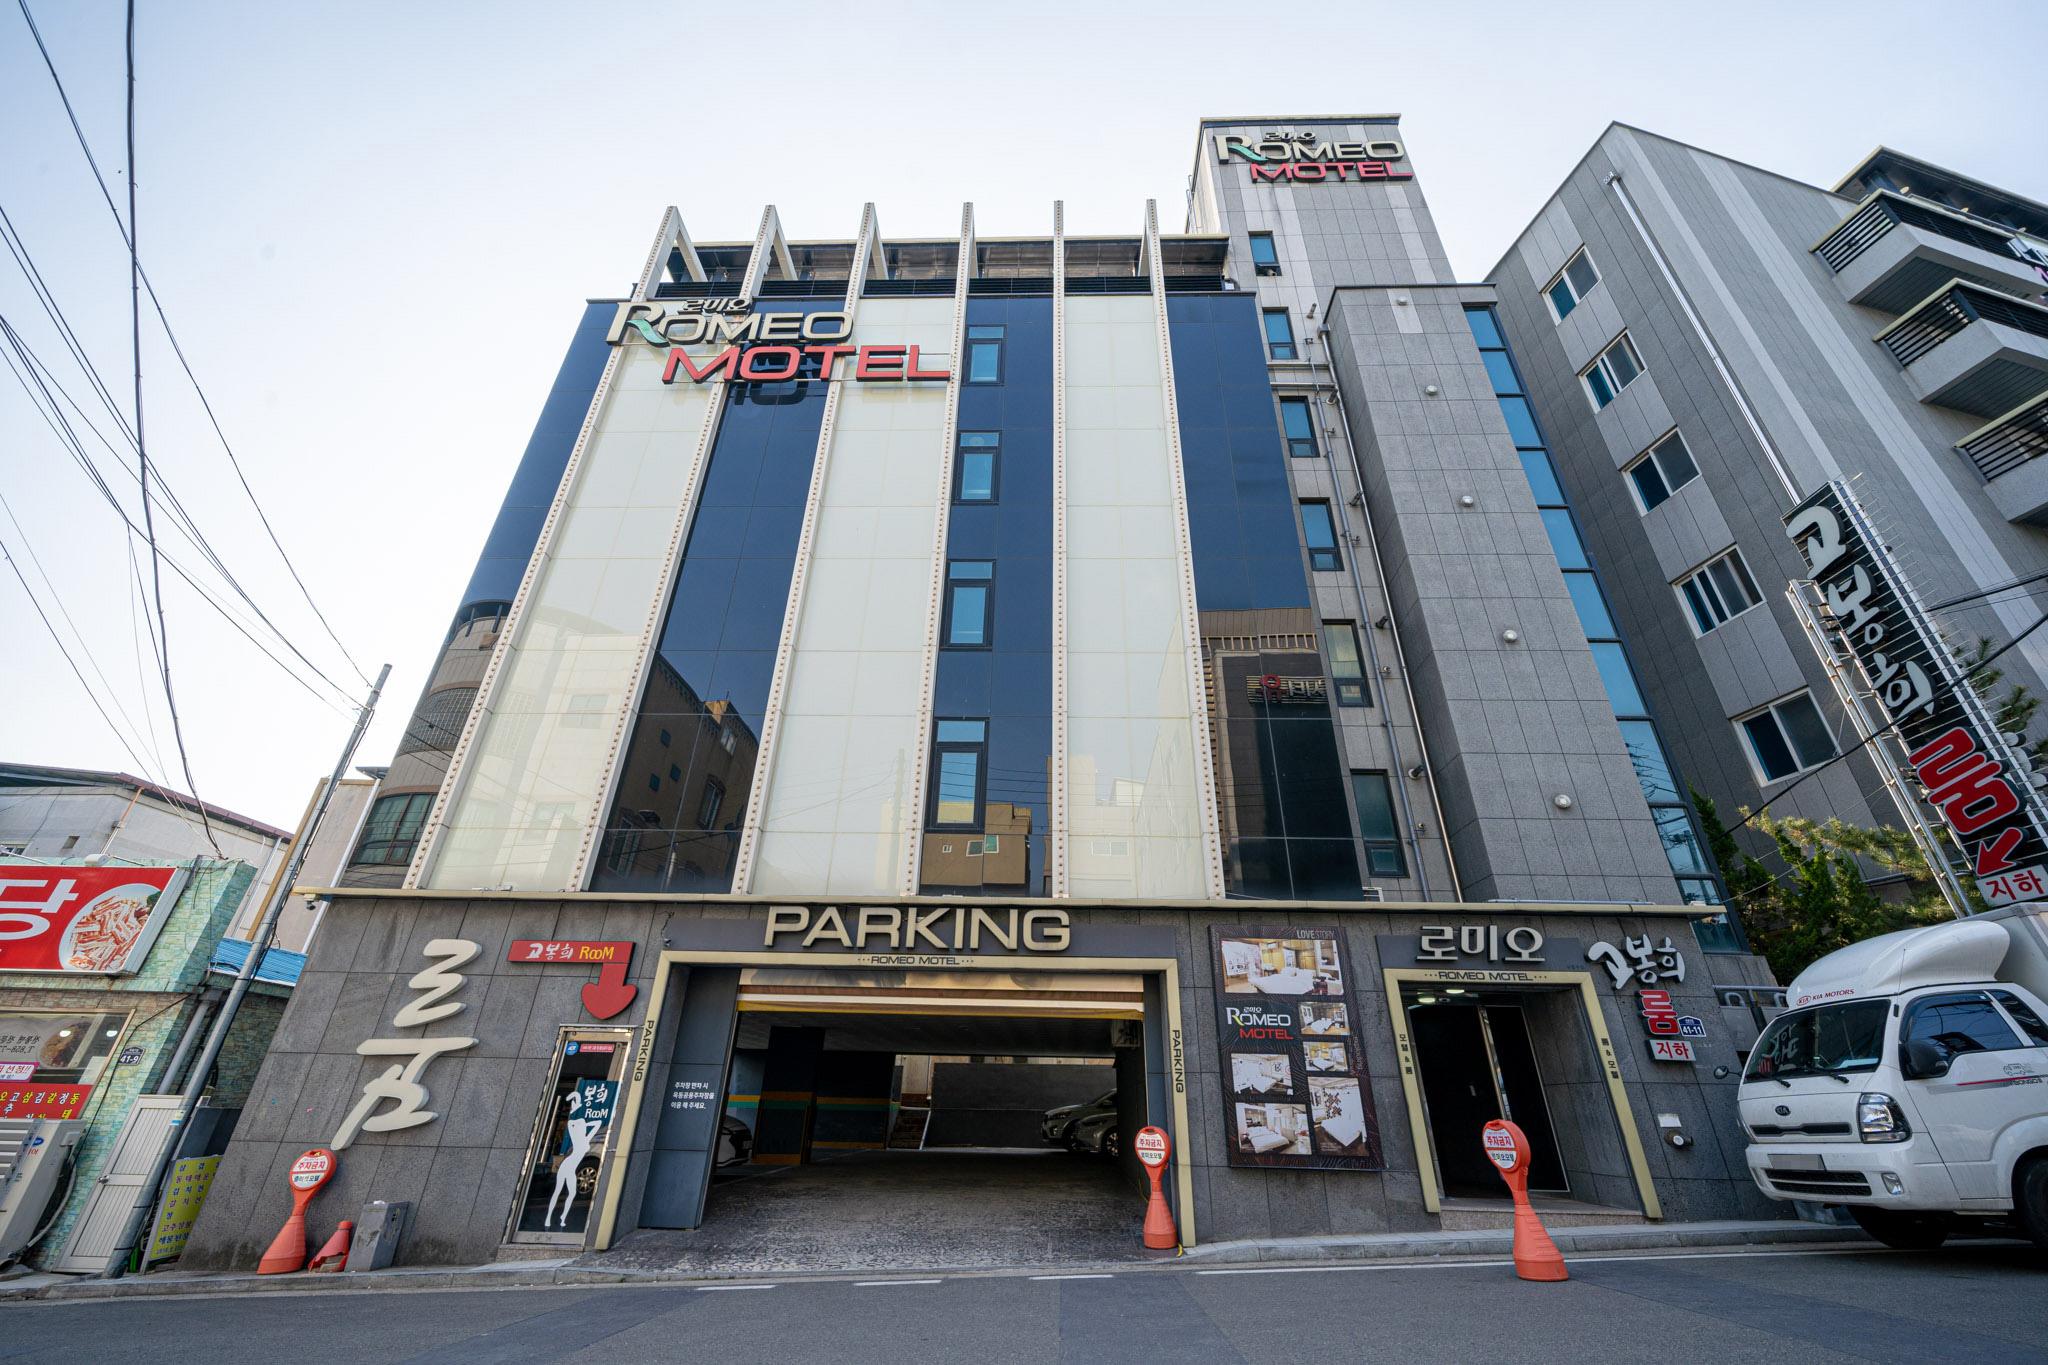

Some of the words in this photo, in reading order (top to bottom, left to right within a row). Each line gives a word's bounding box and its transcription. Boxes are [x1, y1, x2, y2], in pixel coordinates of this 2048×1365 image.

[1264, 131, 1316, 143] 로미오
[1214, 134, 1404, 164] ROMEO
[1250, 161, 1414, 183] MOTEL
[678, 299, 754, 314] 로미오
[605, 301, 854, 348] ROMEO
[662, 345, 951, 384] MOTEL
[1786, 505, 1935, 715] 고봉희
[1908, 727, 2020, 835] 룸
[1985, 869, 2045, 901] 지하
[764, 905, 1071, 951] PARKING
[525, 942, 574, 960] 고봉희
[1416, 924, 1546, 962] 로미오
[870, 955, 916, 965] ROMEO
[918, 956, 961, 966] MOTEL
[1587, 933, 1686, 990] 고봉희
[1438, 971, 1486, 981] ROMEO
[1488, 972, 1534, 982] MOTEL
[1797, 996, 1810, 1005] KIA
[1812, 993, 1824, 1001] KIA
[1824, 988, 1856, 999] MOTORS
[1225, 1007, 1292, 1027] ROMEO
[1638, 989, 1681, 1035] 룸
[1240, 1028, 1295, 1040] MOTEL
[1681, 1025, 1704, 1035] 41-11
[121, 1055, 139, 1063] 41-9
[633, 1020, 656, 1082] PARKING
[1656, 1041, 1690, 1060] 지하
[1172, 1029, 1185, 1094] PARKING
[674, 1082, 691, 1090] 주차장
[691, 1082, 702, 1090] 만차
[702, 1082, 709, 1090] 시
[566, 1084, 608, 1115] 고봉희
[1776, 1105, 1791, 1116] KIA
[1139, 1138, 1163, 1148] 주차금지
[1486, 1135, 1512, 1147] 주차금지
[299, 1160, 326, 1170] 주차금지
